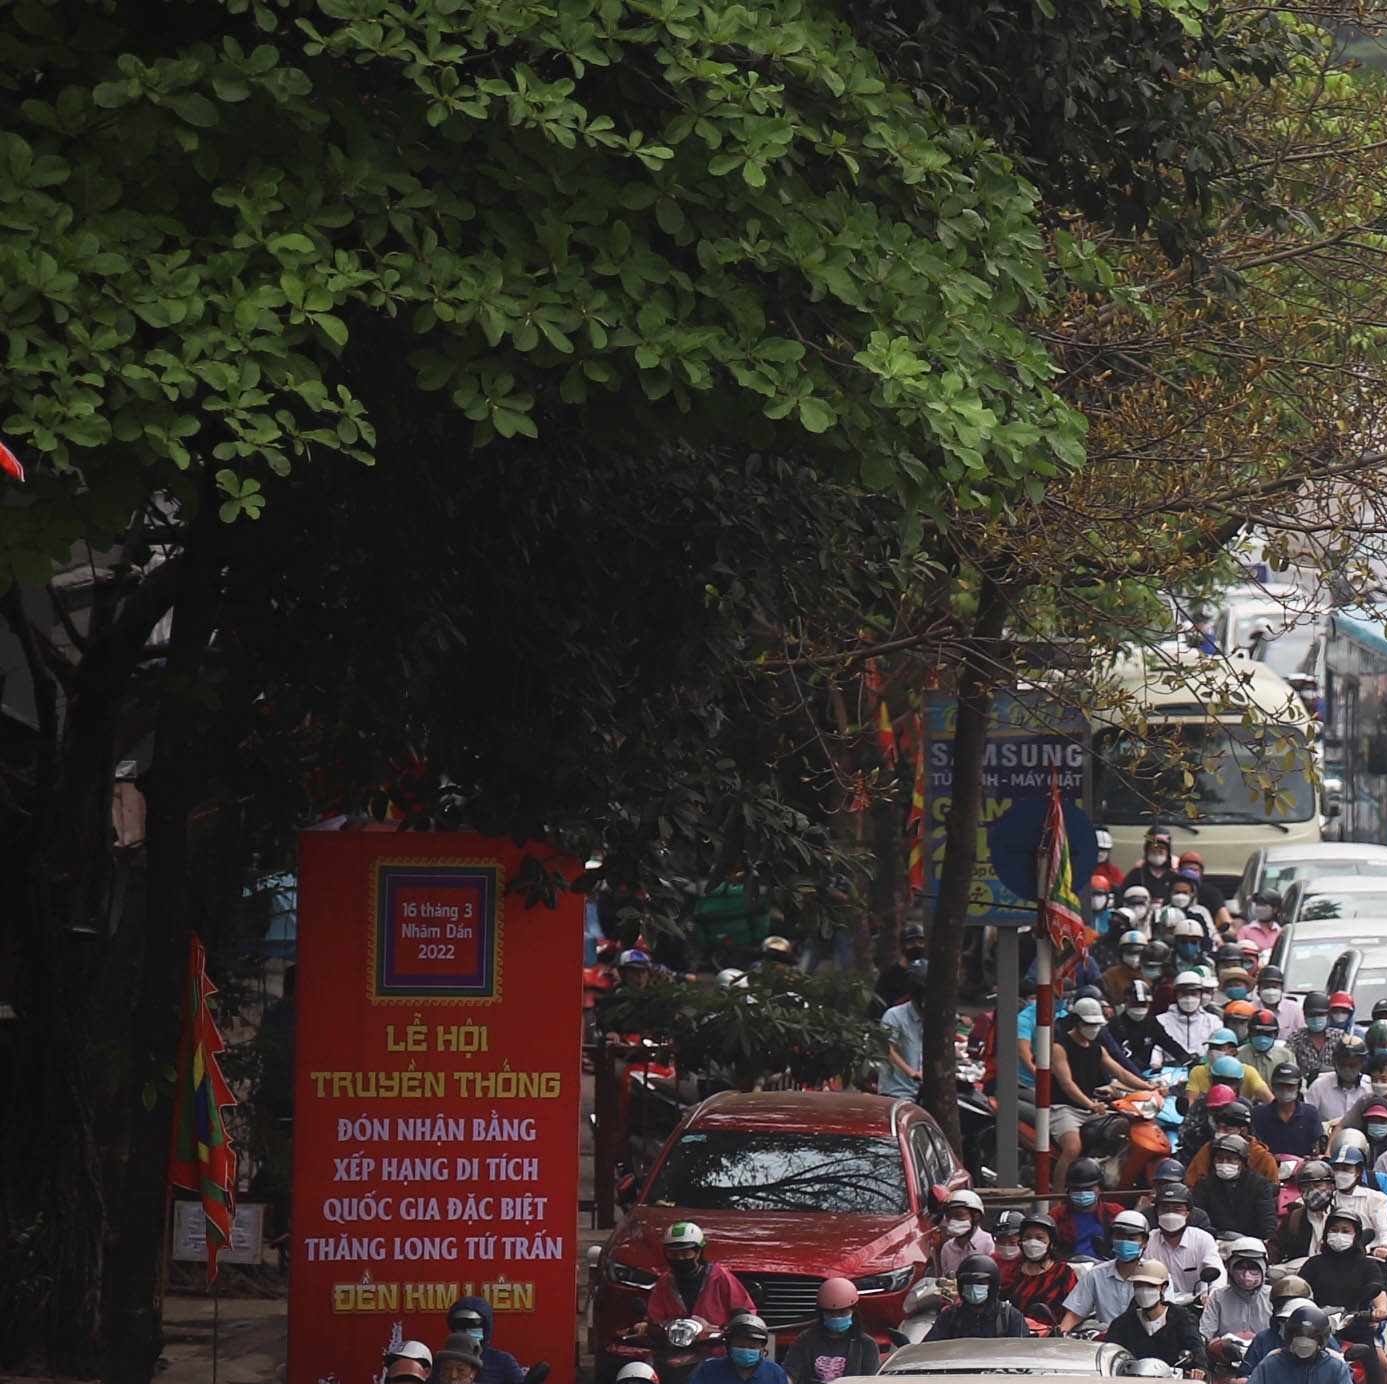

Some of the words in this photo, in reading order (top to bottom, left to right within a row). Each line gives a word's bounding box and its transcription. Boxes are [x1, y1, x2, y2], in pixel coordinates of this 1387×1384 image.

[932, 742, 1083, 767] SMSUNG
[1011, 770, 1044, 786] MÁY
[402, 903, 417, 918] 16
[420, 902, 459, 920] tháng
[464, 903, 473, 918] 3
[401, 924, 441, 939] Nhâm
[418, 944, 456, 960] 2022
[386, 1012, 428, 1052] LỄ
[436, 1016, 489, 1059] HỘI
[310, 1058, 446, 1098] TRUYỀN
[453, 1058, 561, 1098] THỐNG
[337, 1113, 390, 1141] ĐÓN
[397, 1113, 465, 1146] NHẬN
[472, 1109, 537, 1141] BẰNG
[333, 1151, 376, 1181] XẾP
[381, 1158, 448, 1186] HẠNG
[456, 1158, 479, 1181] DI
[486, 1153, 539, 1181] TÍCH
[323, 1190, 393, 1225] QUỐC
[400, 1197, 441, 1221] GIA
[447, 1193, 494, 1225] ĐẶC
[500, 1193, 548, 1225] BIỆT
[304, 1233, 386, 1261] THĂNG
[393, 1237, 458, 1261] LONG
[465, 1232, 498, 1260] TỨ
[501, 1229, 563, 1260] TRẤN
[334, 1268, 398, 1311] ĐỀN
